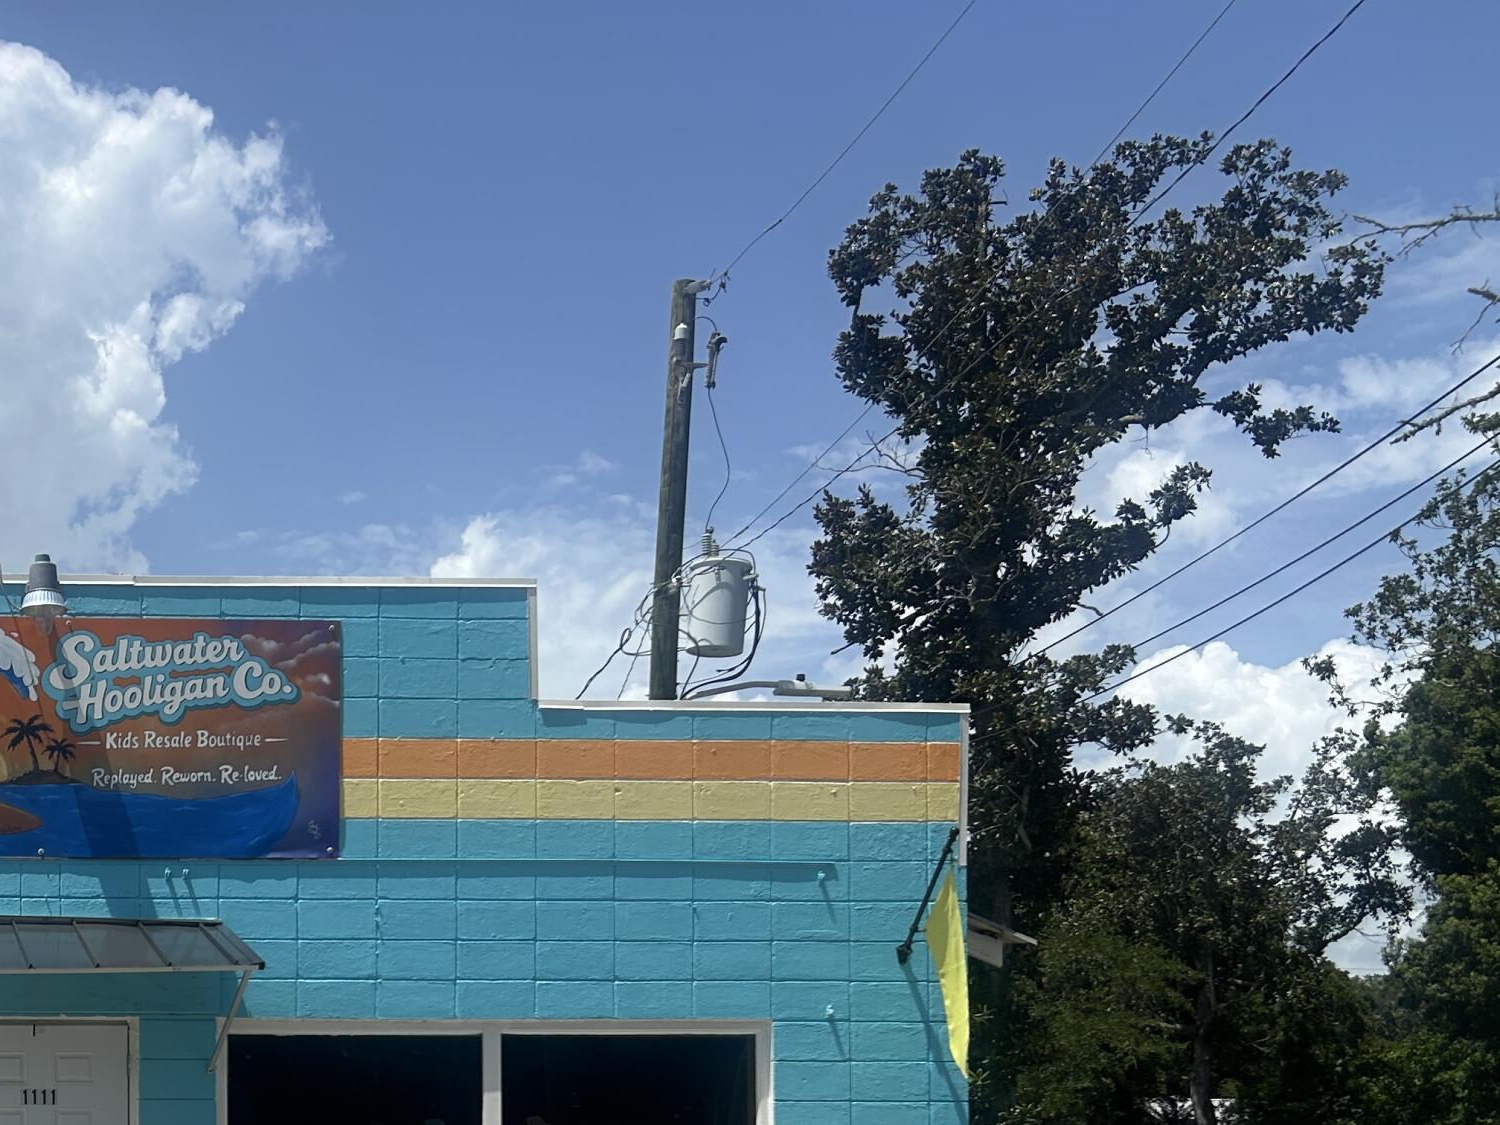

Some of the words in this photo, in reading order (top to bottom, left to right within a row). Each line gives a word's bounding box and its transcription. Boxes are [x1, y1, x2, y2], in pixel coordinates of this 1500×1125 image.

[49, 634, 244, 690] Saltwater
[63, 674, 229, 724] Hooligan
[233, 661, 292, 699] Co.
[105, 732, 139, 749] Kids
[144, 730, 191, 749] Resale
[197, 730, 261, 751] Boutique
[91, 767, 157, 789] Replayed.
[161, 766, 216, 785] Reworn.
[220, 764, 282, 784] Re-loved.
[22, 1088, 56, 1105] 1111
